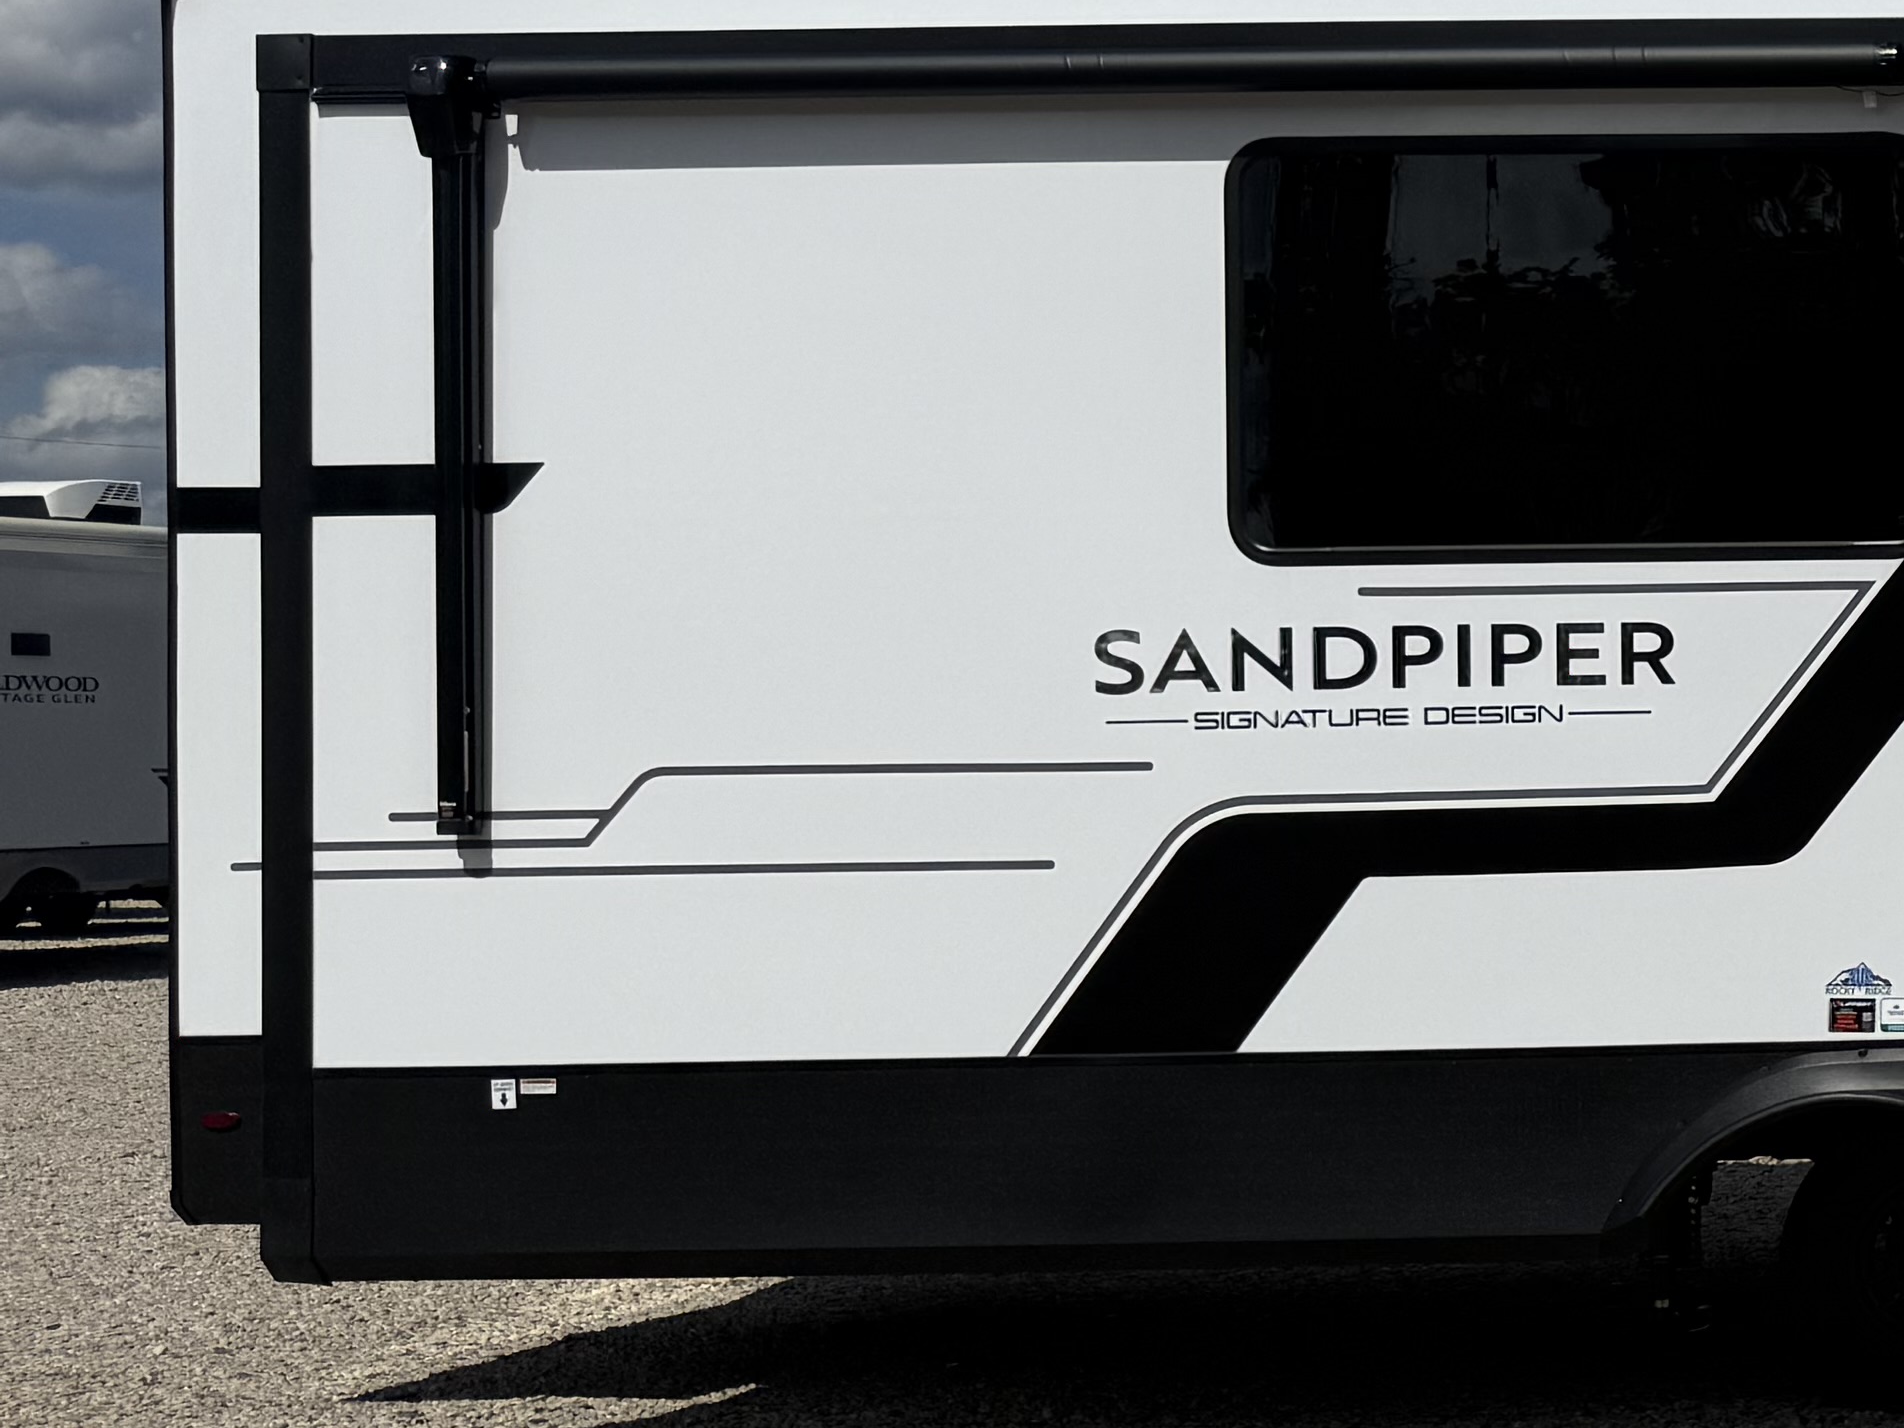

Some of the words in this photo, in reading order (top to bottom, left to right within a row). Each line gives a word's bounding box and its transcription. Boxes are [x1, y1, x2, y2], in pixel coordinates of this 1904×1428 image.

[1093, 622, 1676, 695] SANDPIPER
[52, 694, 96, 704] GLEN
[1193, 707, 1409, 731] SIGNATURE
[1424, 704, 1565, 726] DESIGN
